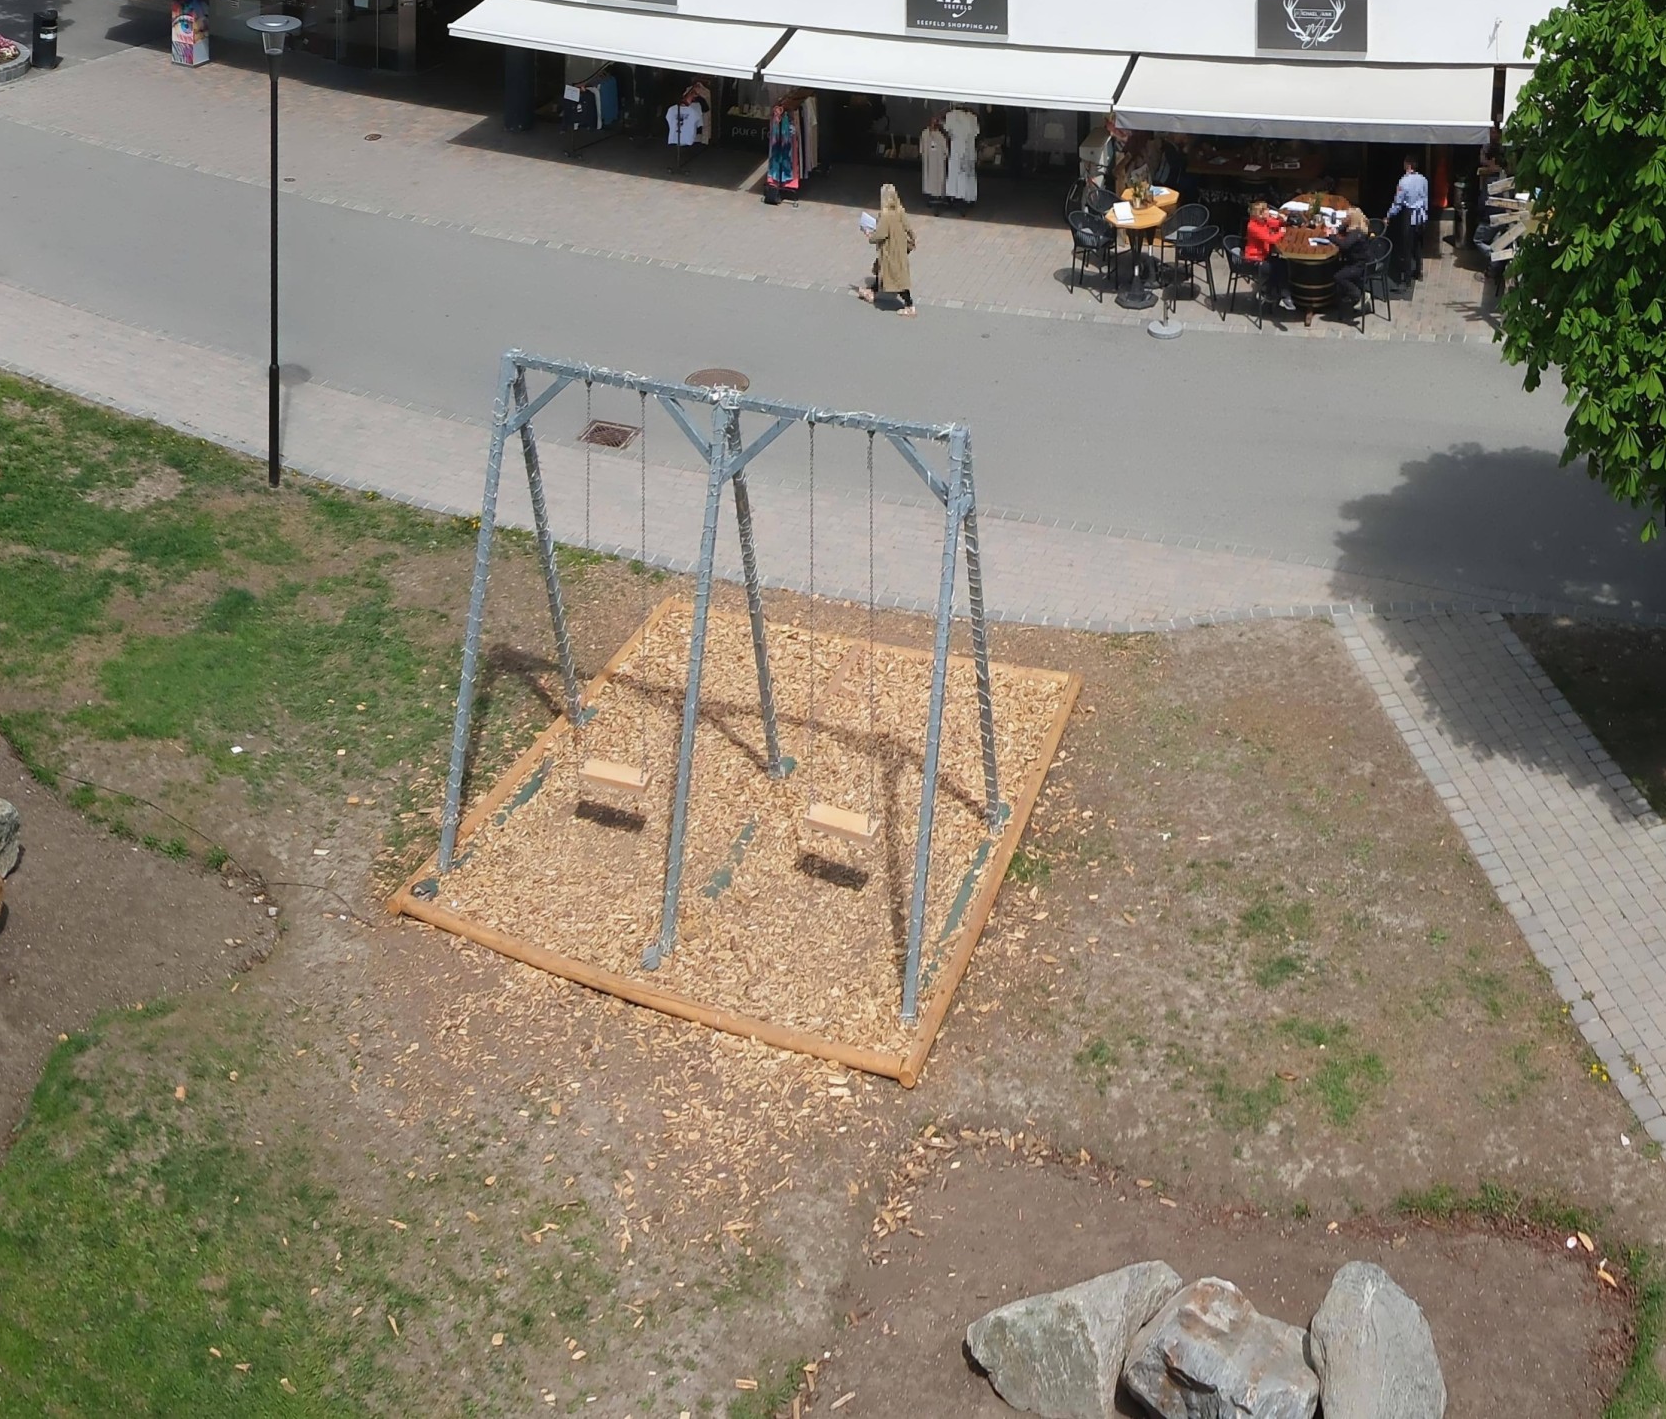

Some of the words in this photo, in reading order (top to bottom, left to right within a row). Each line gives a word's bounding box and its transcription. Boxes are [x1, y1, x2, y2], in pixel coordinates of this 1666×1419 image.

[943, 3, 973, 11] SEEFELD
[947, 22, 983, 30] SHOPPING
[732, 126, 758, 137] pure
